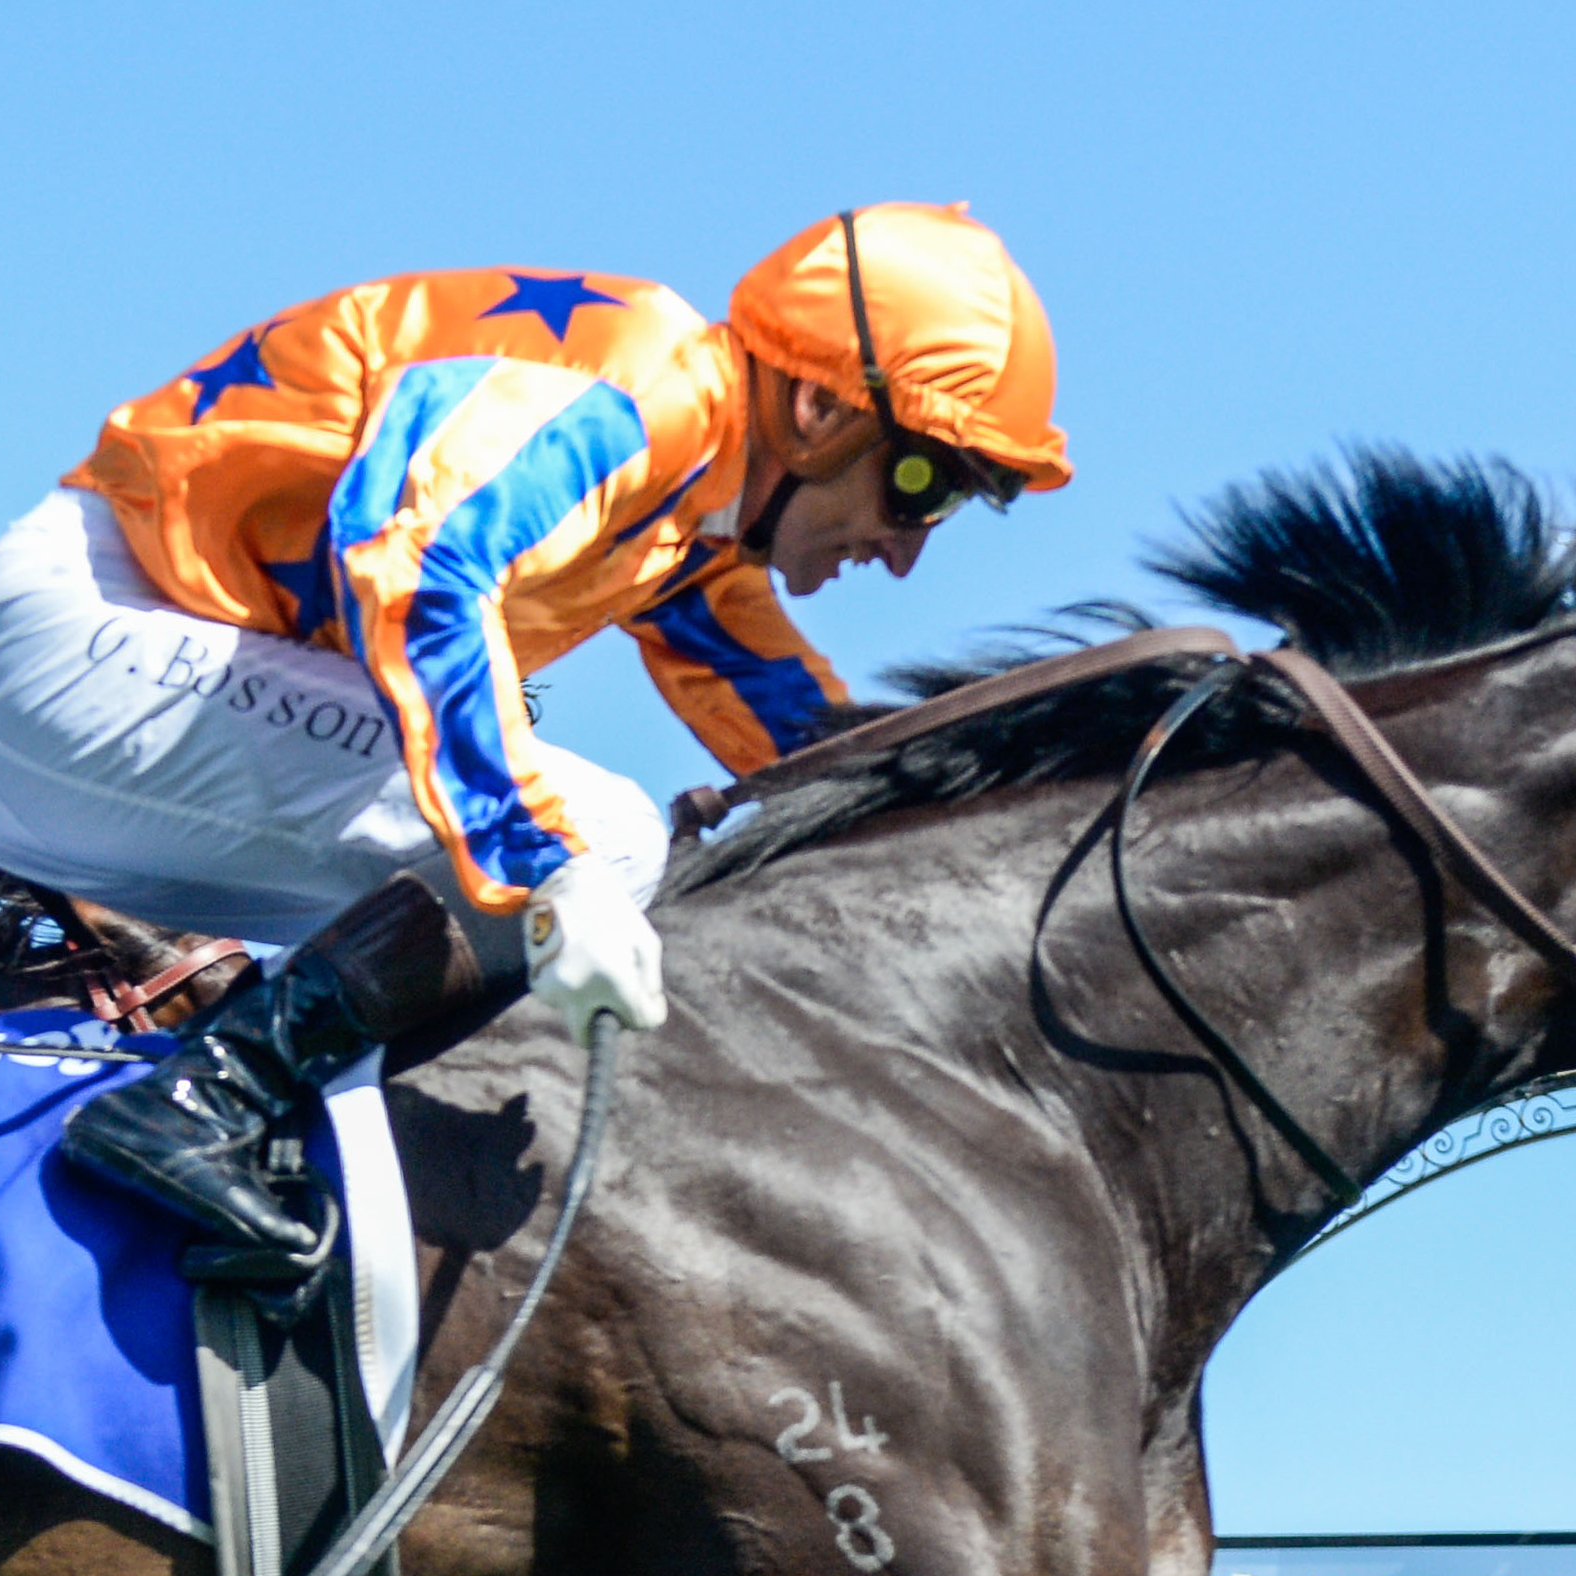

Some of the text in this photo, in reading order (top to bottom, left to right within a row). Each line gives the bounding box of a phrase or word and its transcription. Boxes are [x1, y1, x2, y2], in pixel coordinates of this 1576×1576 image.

[156, 635, 386, 757] Bosson
[768, 1381, 891, 1464] 24
[826, 1484, 896, 1574] 8
